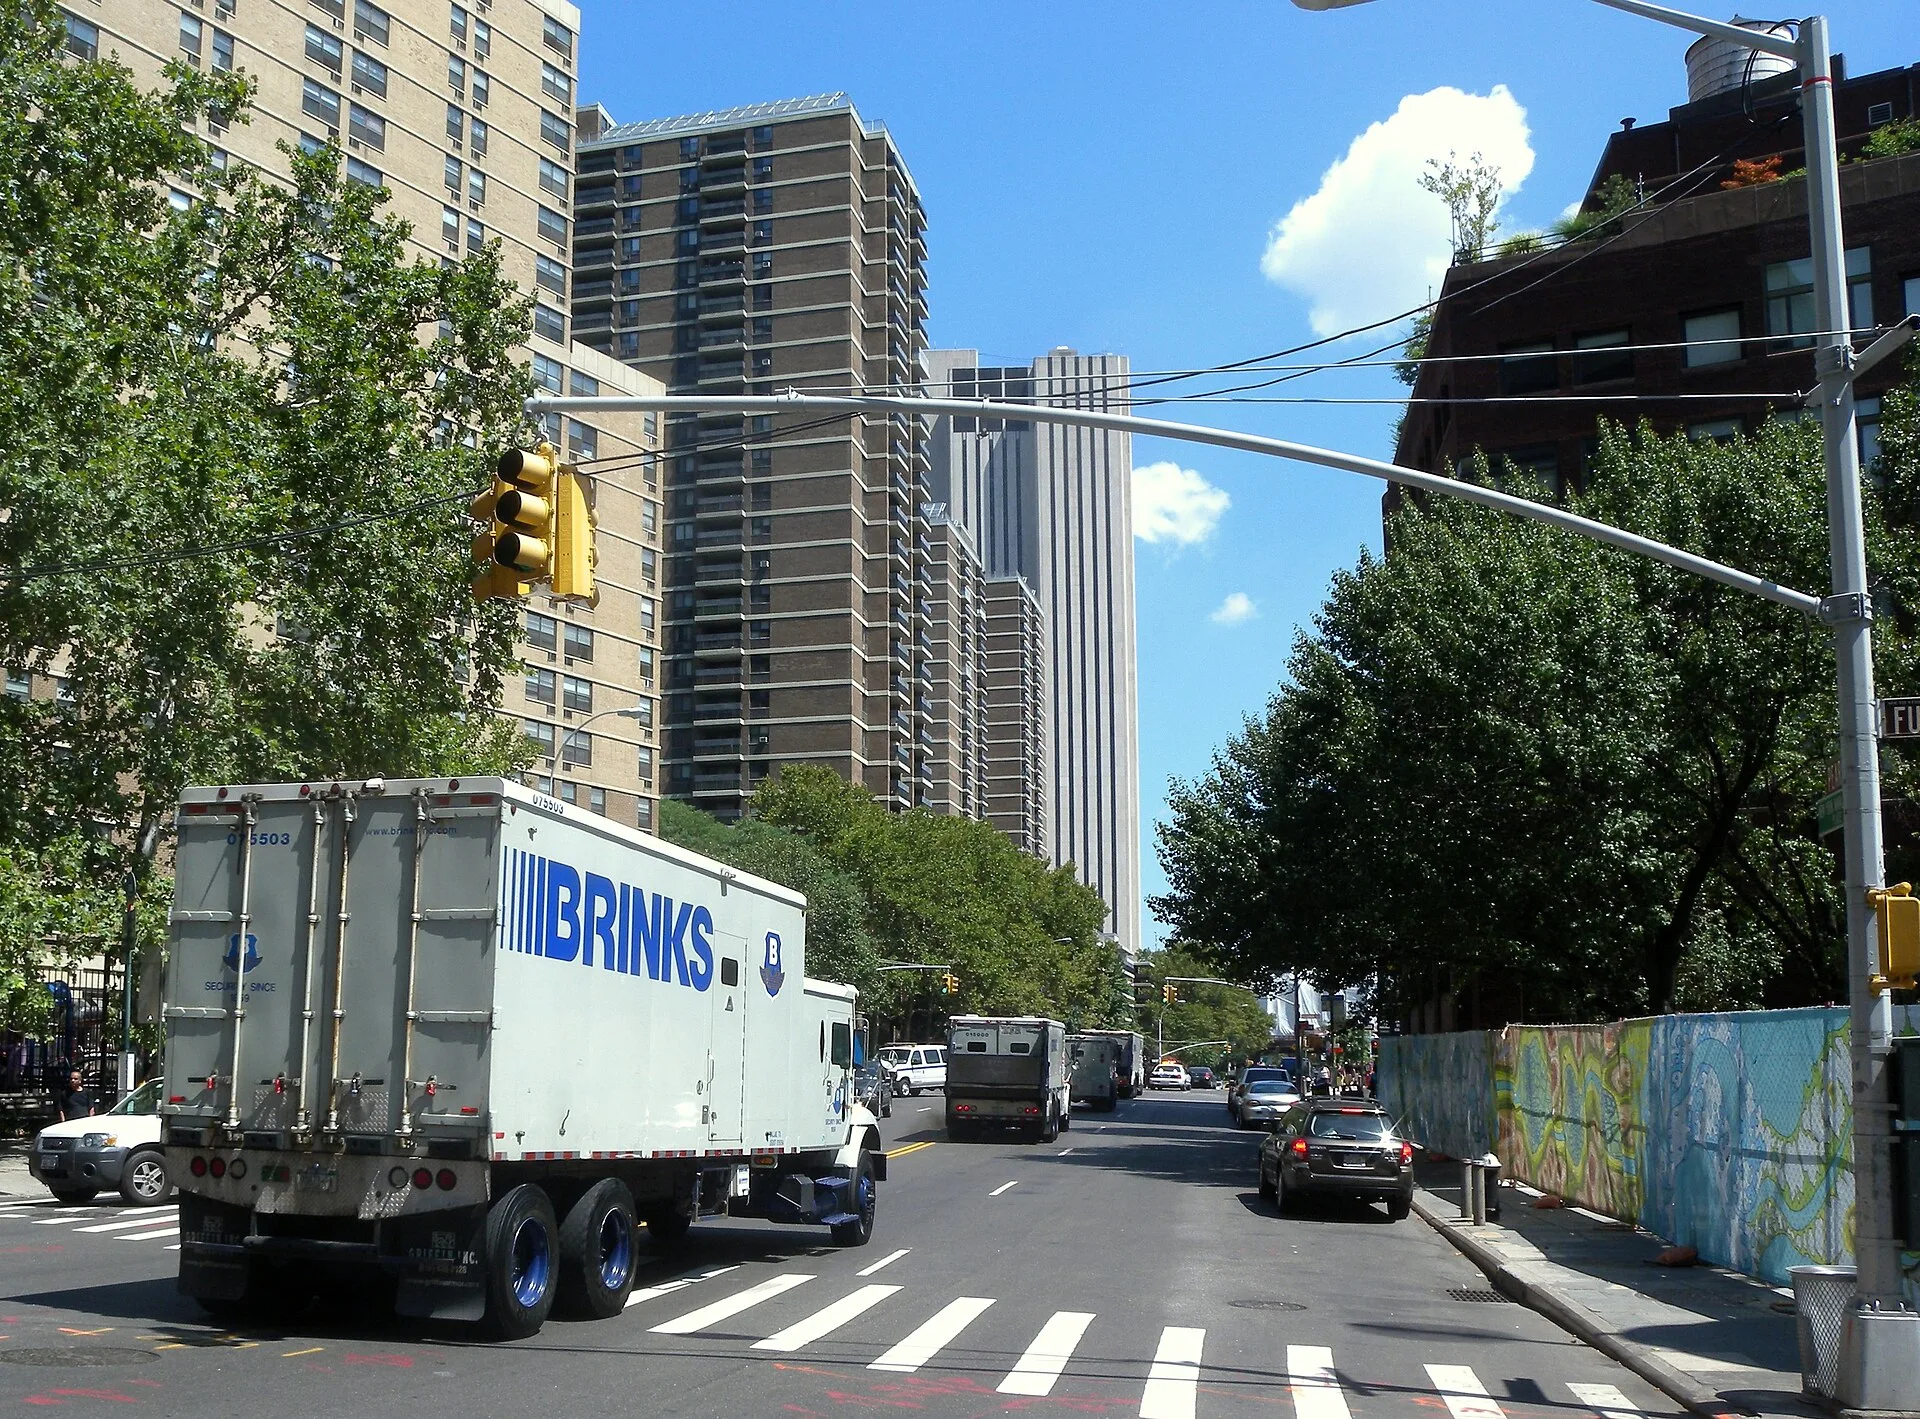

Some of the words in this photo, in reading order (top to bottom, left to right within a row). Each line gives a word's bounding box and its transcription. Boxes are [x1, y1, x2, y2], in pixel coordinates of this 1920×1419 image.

[532, 794, 564, 814] 075503
[226, 832, 290, 846] 05503
[545, 859, 714, 992] BRINKS
[769, 937, 778, 966] B
[205, 981, 248, 991] SECURY
[250, 982, 277, 992] SINCE
